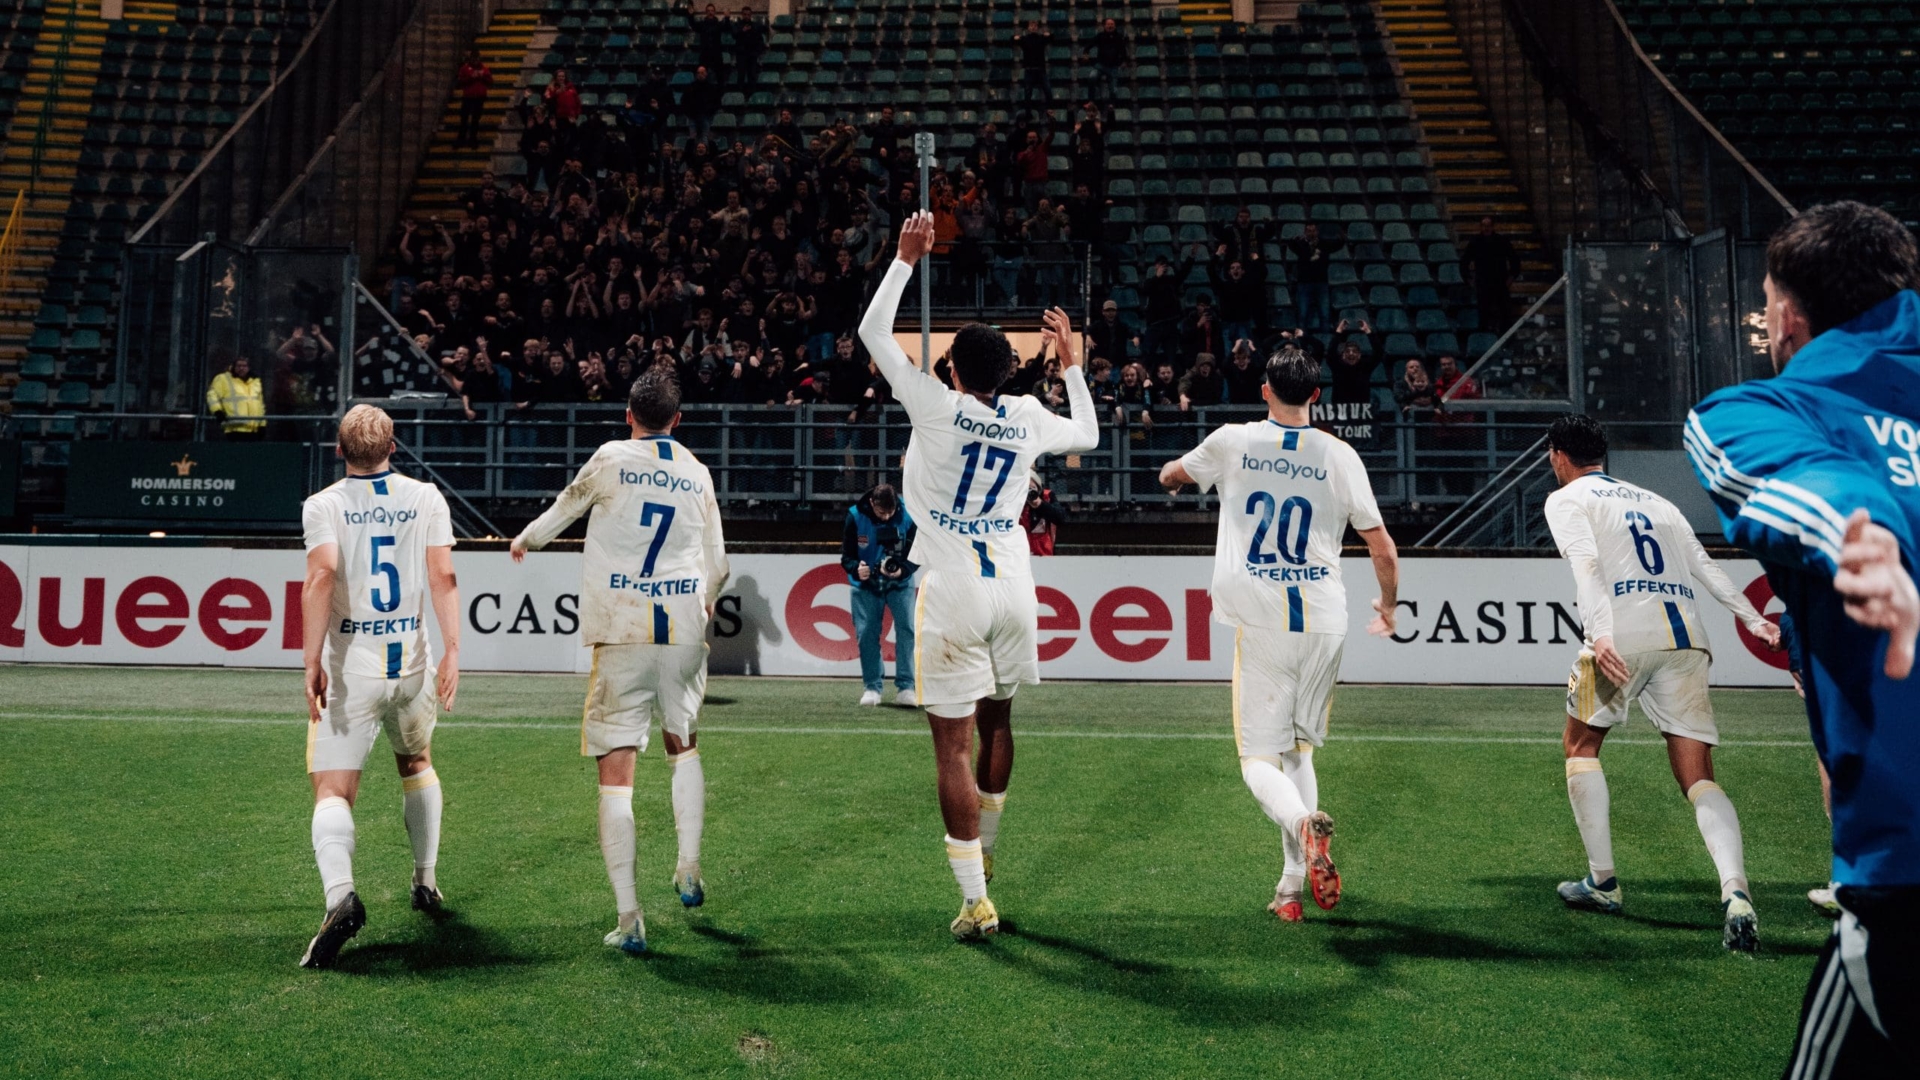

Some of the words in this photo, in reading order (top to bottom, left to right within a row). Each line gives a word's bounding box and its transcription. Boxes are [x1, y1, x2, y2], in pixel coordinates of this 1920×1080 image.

[1311, 403, 1373, 421] MBUUR
[1333, 425, 1372, 438] TOUR
[131, 477, 236, 491] HOMMERSON
[619, 468, 704, 494] tanQyou
[951, 440, 1018, 517] 17
[1242, 453, 1327, 481] tanQyou
[141, 495, 224, 507] CASINO
[344, 506, 417, 527] tanQyou
[639, 501, 676, 578] 7
[1245, 491, 1313, 565] 20
[1625, 510, 1664, 576] 6
[370, 535, 401, 613] 5
[0, 559, 303, 650] uee
[469, 593, 742, 638] CASS
[1389, 600, 1583, 645] CASIN
